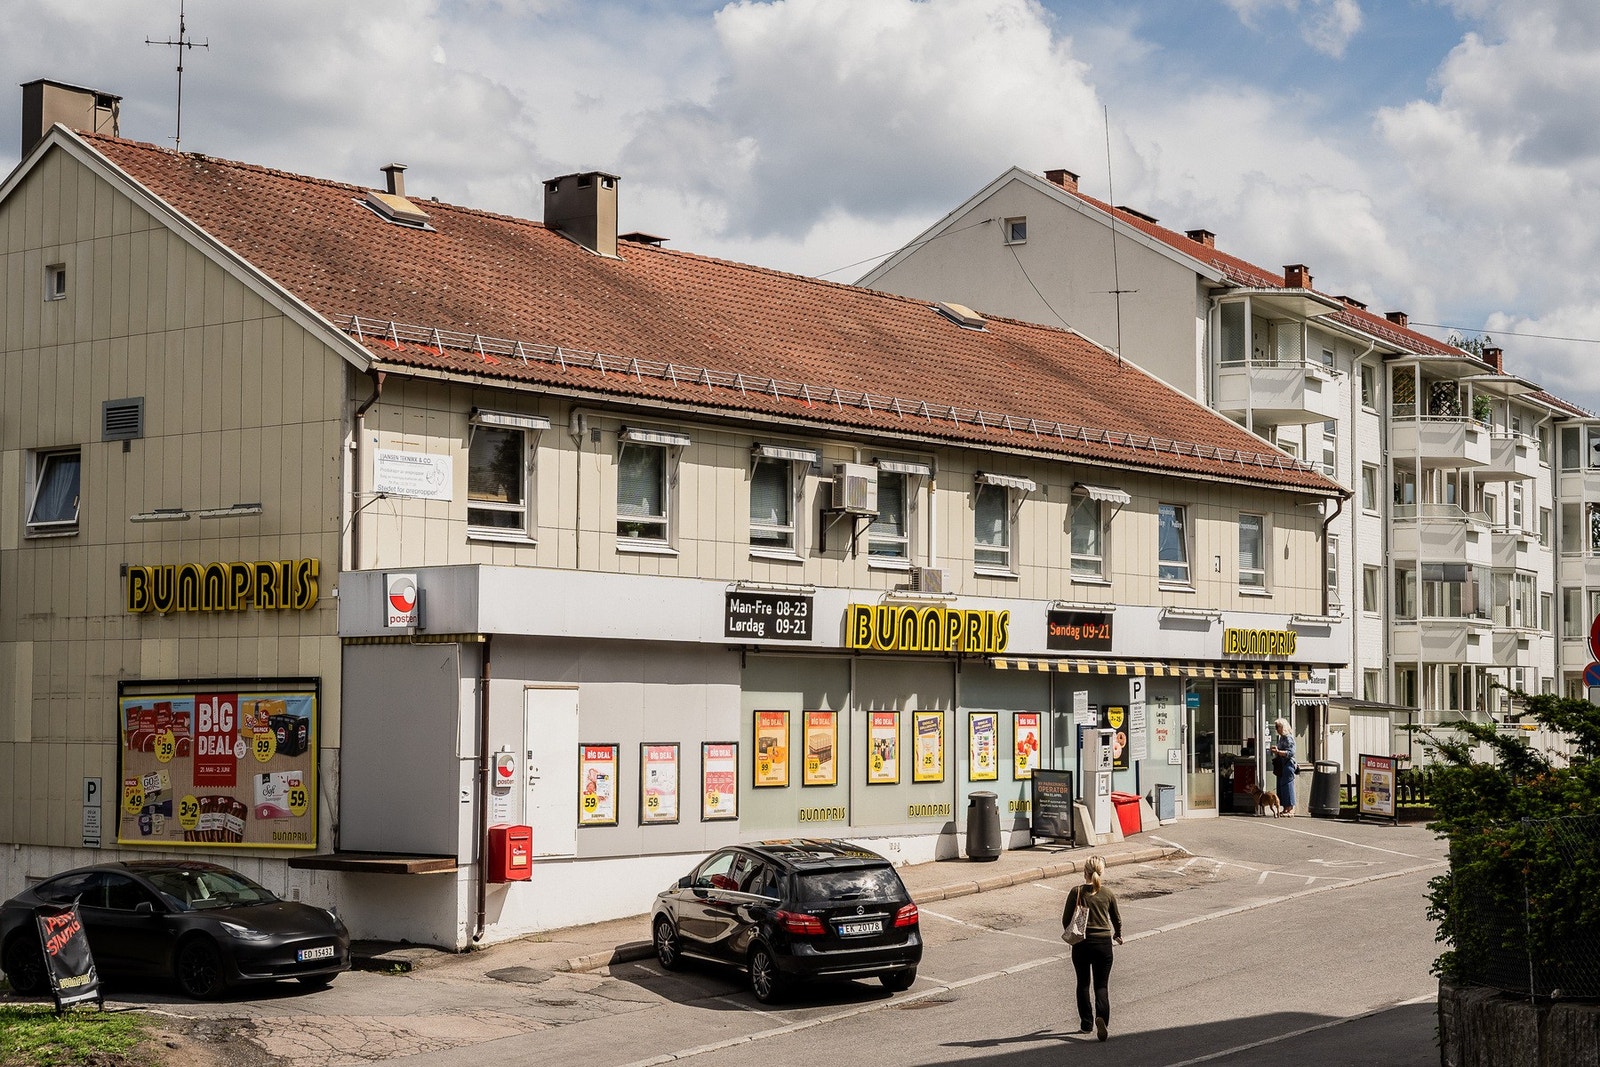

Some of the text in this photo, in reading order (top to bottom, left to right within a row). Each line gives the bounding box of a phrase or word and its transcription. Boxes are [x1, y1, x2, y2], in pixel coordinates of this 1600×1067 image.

[127, 558, 319, 613] BUNNPRIS
[730, 598, 808, 617] Man-Fre 08-23
[390, 613, 417, 625] posten
[729, 616, 807, 637] Lørdag 09-21
[845, 604, 1011, 654] BUNNPRIS
[1050, 621, 1110, 641] Søndag 09-21
[1223, 628, 1297, 656] BUNNPRIS
[1133, 681, 1142, 700] P
[198, 735, 233, 755] DEAL
[597, 751, 611, 759] DEAL
[87, 781, 97, 803] P
[1037, 786, 1068, 794] OPERATOR
[800, 807, 846, 821] BUNNPRIS
[909, 804, 951, 816] BUNNPRIS
[845, 922, 880, 933] EK 20178
[315, 947, 333, 957] 15432
